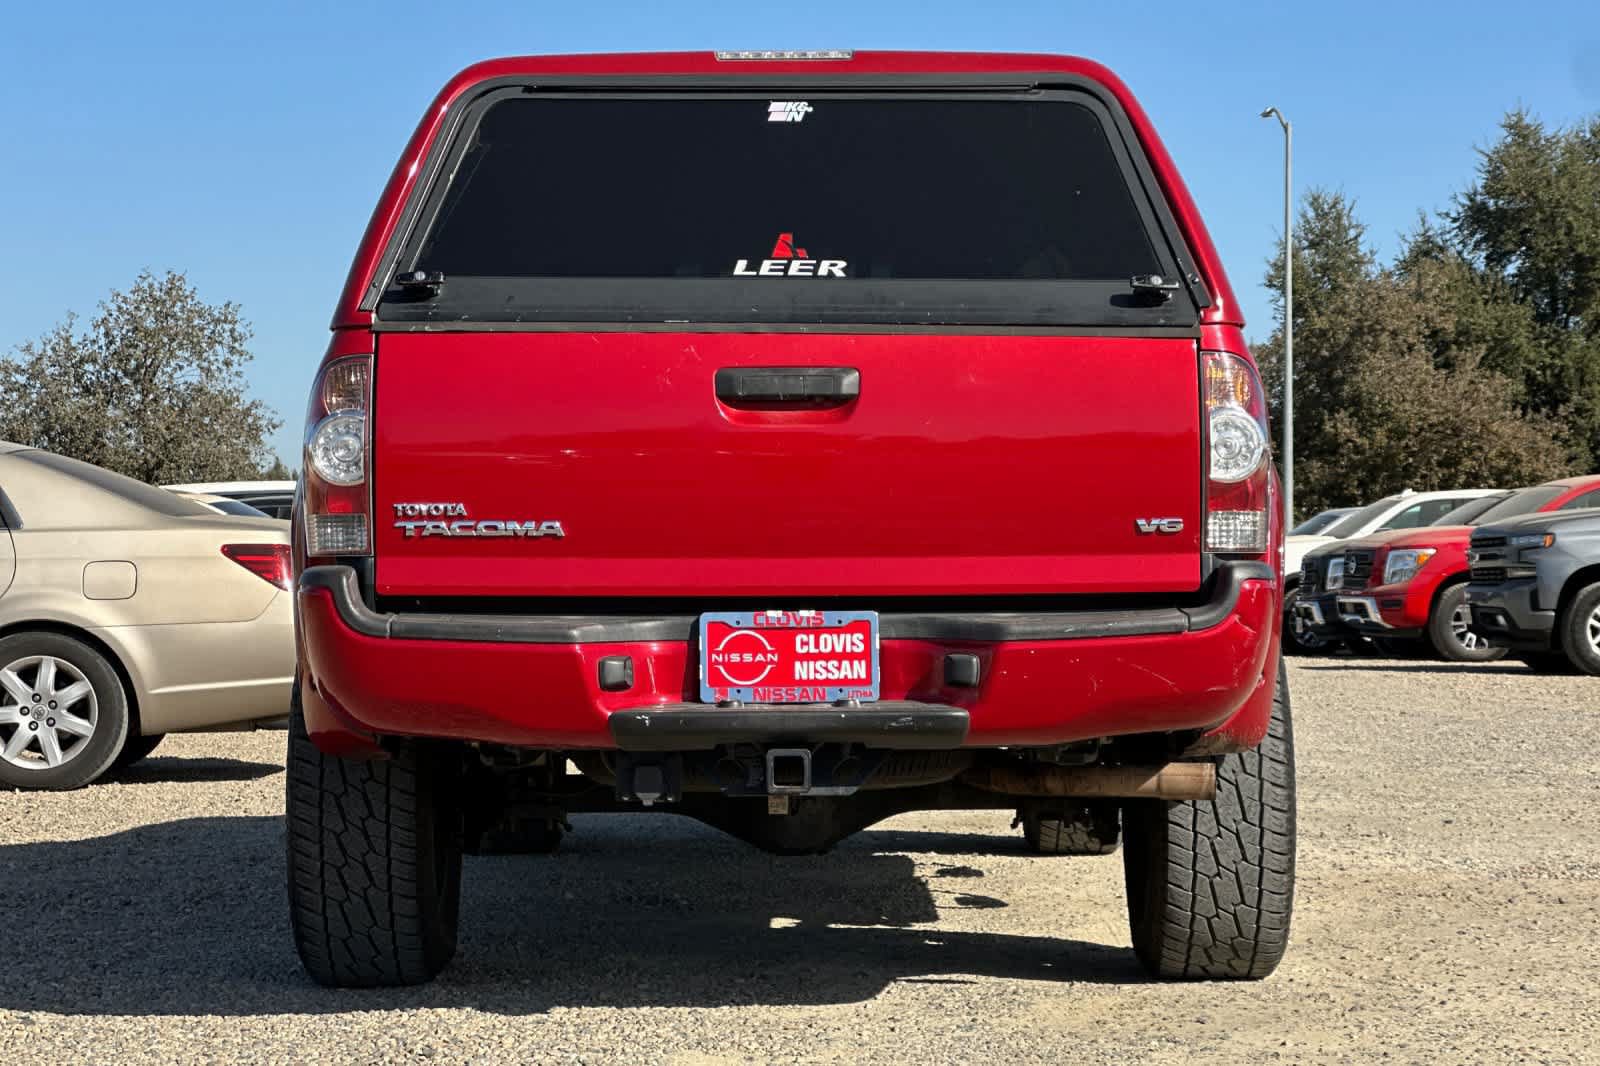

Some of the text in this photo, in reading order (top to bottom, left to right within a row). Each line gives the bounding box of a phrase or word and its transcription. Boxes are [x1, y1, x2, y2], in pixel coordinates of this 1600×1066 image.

[733, 259, 848, 277] LEER
[393, 502, 467, 516] TOYOTA
[394, 519, 566, 537] TACOMA
[1136, 517, 1184, 533] V6
[753, 611, 825, 627] CLOVIS
[795, 633, 865, 654] CLOVIS
[711, 653, 779, 663] NISSAN
[794, 660, 867, 681] NISSAN
[752, 688, 827, 702] NISSAN
